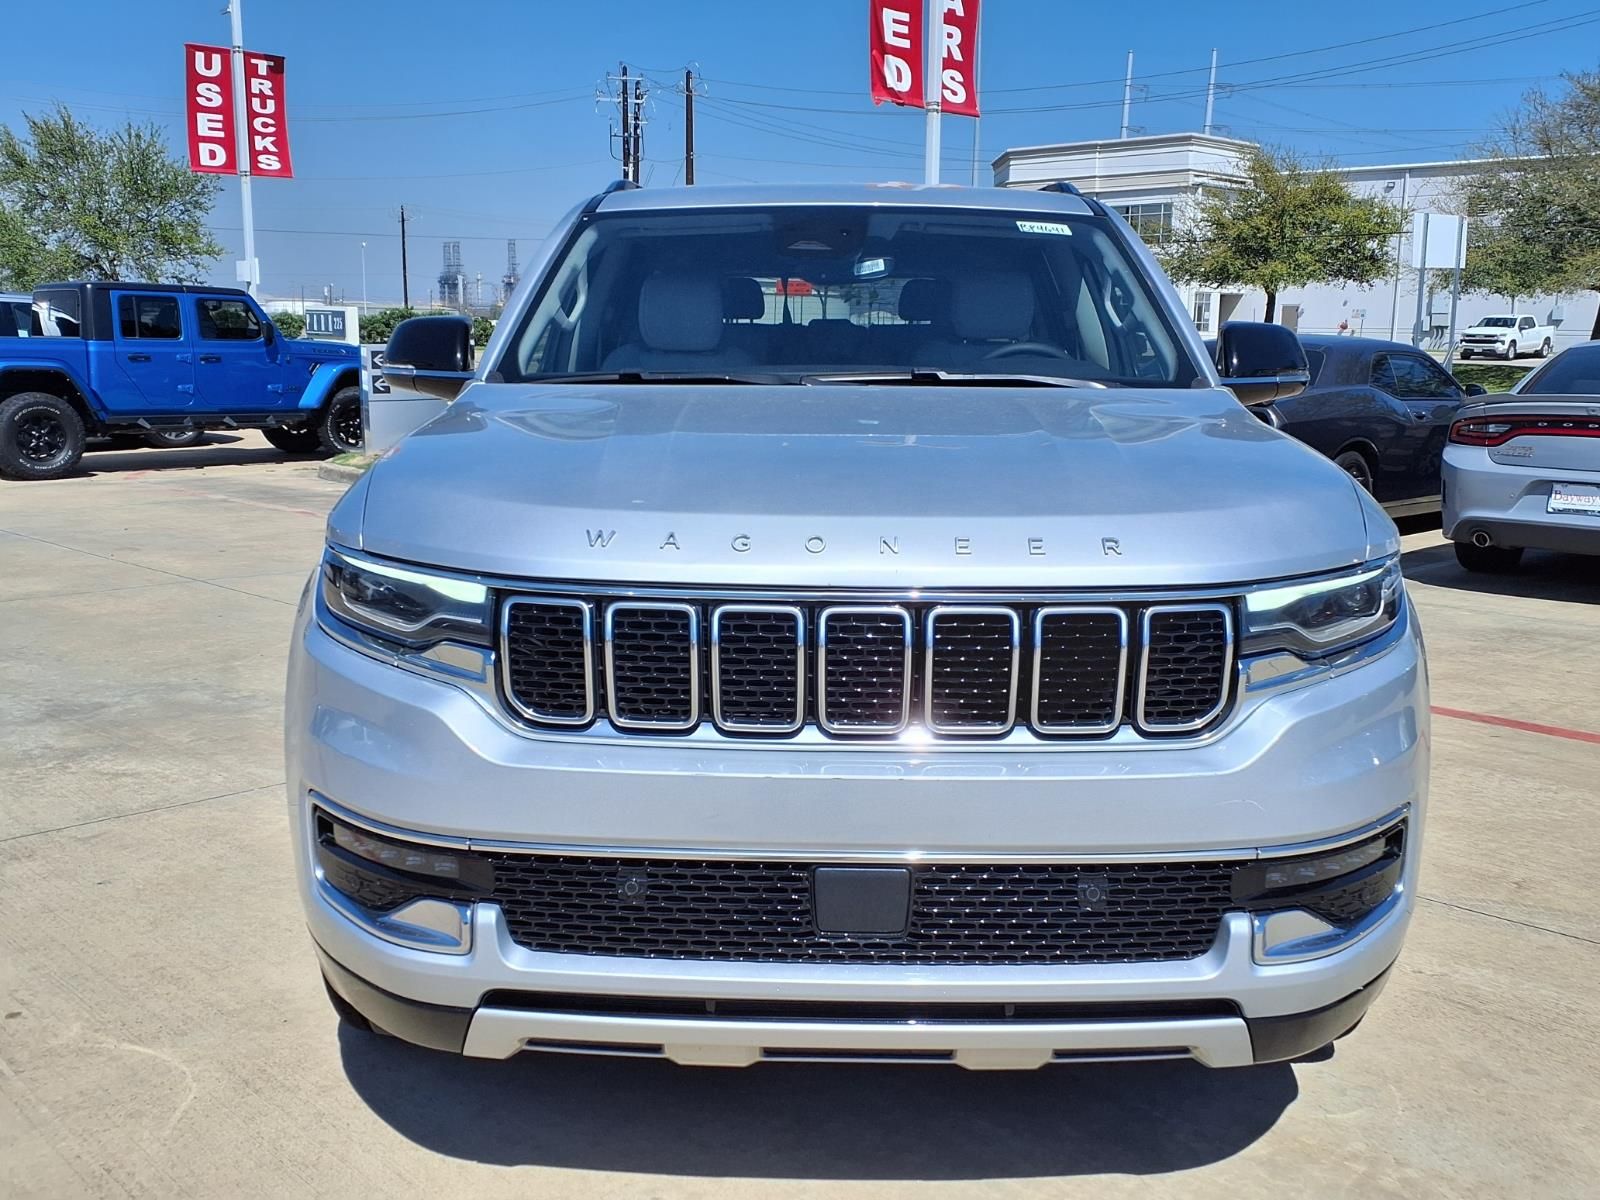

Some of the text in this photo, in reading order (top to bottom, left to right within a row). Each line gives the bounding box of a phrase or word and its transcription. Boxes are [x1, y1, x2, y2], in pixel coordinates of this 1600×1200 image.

[195, 51, 226, 167] USED
[250, 58, 282, 171] TRUCKS
[586, 529, 1123, 556] WAGONEER
